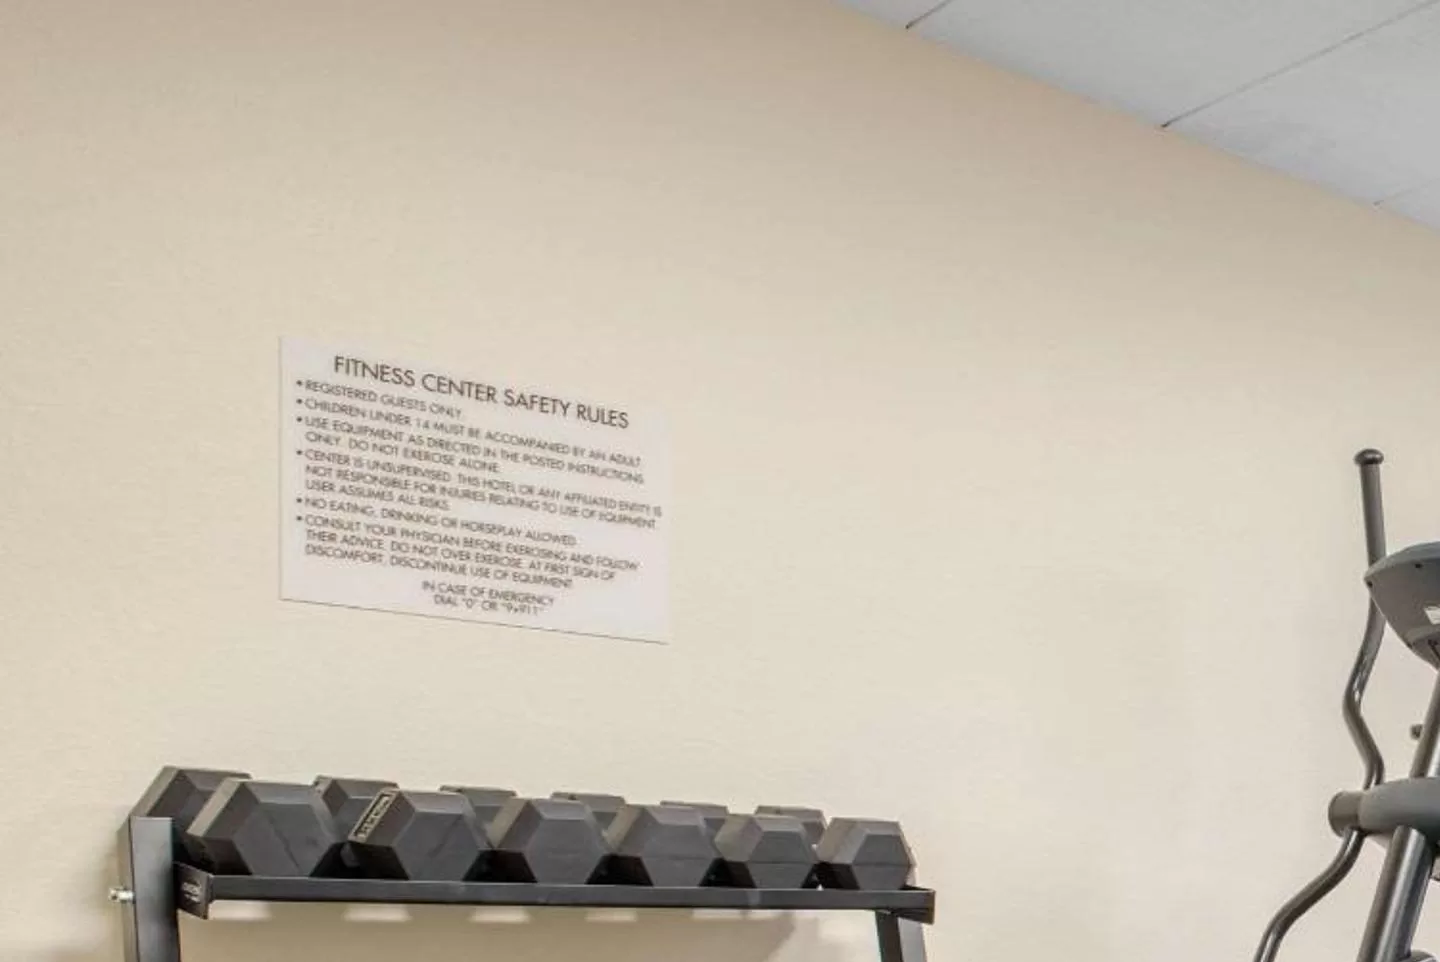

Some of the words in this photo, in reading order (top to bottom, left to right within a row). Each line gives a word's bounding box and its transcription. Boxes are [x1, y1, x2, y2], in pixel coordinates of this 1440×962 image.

[305, 380, 378, 402] REGISTERED
[380, 394, 426, 412] GUESTS
[429, 402, 462, 418] ONLY
[334, 355, 415, 387] FITNESS
[421, 373, 498, 403] CENTER
[503, 389, 571, 417] SAFETY
[576, 404, 629, 429] RULES
[304, 398, 366, 418] CHILDREN
[369, 409, 411, 426] UNDER
[416, 418, 429, 430] 14
[433, 421, 465, 436] MUST
[484, 431, 571, 456] ACCOMPANIED
[572, 445, 585, 457] BY
[589, 448, 606, 461] AN
[305, 416, 328, 428] USE
[332, 420, 405, 442] EQUIPMENT
[408, 434, 425, 446] AS
[427, 437, 480, 456] DIRECTED
[483, 446, 497, 458] IN
[500, 448, 522, 463] THE
[523, 453, 565, 471] POSTED
[349, 439, 369, 450] DO
[372, 443, 399, 456] NOT
[403, 448, 456, 466] EXERCISE
[305, 450, 350, 465] CENTER
[458, 473, 480, 486] THIS
[482, 477, 516, 494] HOTEL
[519, 484, 534, 495] OR
[305, 479, 335, 492] USER
[305, 465, 332, 477] NOT
[337, 469, 413, 490] RESPONSIBLE
[414, 481, 436, 493] FOR
[560, 506, 579, 517] USE
[581, 508, 596, 519] OF
[305, 498, 327, 510] NO
[381, 508, 438, 526] DRINKING
[441, 517, 457, 528] OR
[461, 521, 522, 537] HORSEPLAY
[305, 514, 360, 531] CONSULT
[365, 523, 396, 536] YOUR
[401, 527, 460, 546] PHYSICIAN
[463, 536, 501, 551] BEFORE
[570, 552, 594, 564] AND
[306, 530, 337, 543] THEIR
[391, 541, 410, 552] DO
[412, 543, 438, 556] NOT
[441, 547, 471, 561] OVER
[422, 580, 435, 592] IN
[438, 582, 468, 595] CASE
[470, 585, 486, 598] OF
[470, 566, 490, 579] USE
[494, 568, 508, 580] OF
